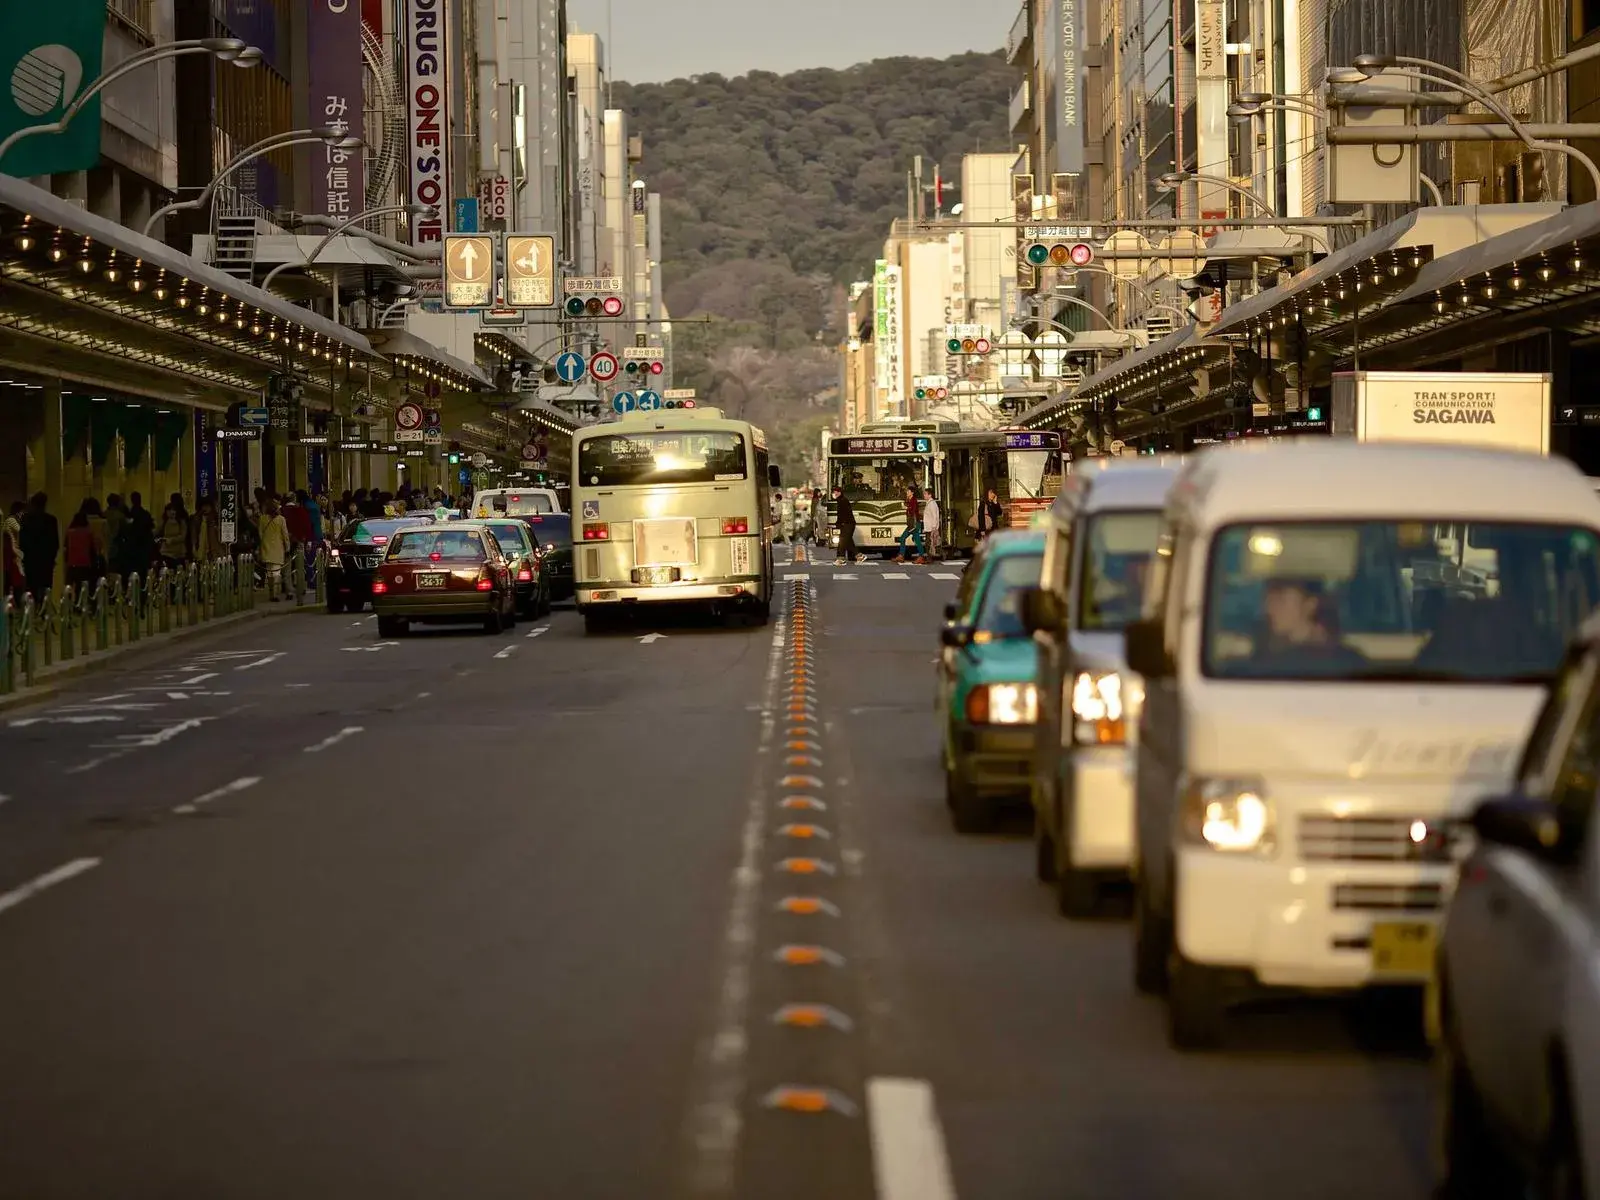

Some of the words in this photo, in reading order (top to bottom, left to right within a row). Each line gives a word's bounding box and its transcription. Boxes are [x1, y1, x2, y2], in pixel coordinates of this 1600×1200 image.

[1063, 12, 1074, 47] KYOTO
[1064, 50, 1075, 93] SHINKIN
[1064, 96, 1076, 126] BANK
[495, 175, 508, 220] doco
[567, 280, 619, 290] 歩車分離信号
[889, 287, 898, 392] TAKASHIMAYA
[596, 361, 612, 373] 40
[1413, 409, 1496, 424] SAGAWA
[896, 440, 909, 450] 5
